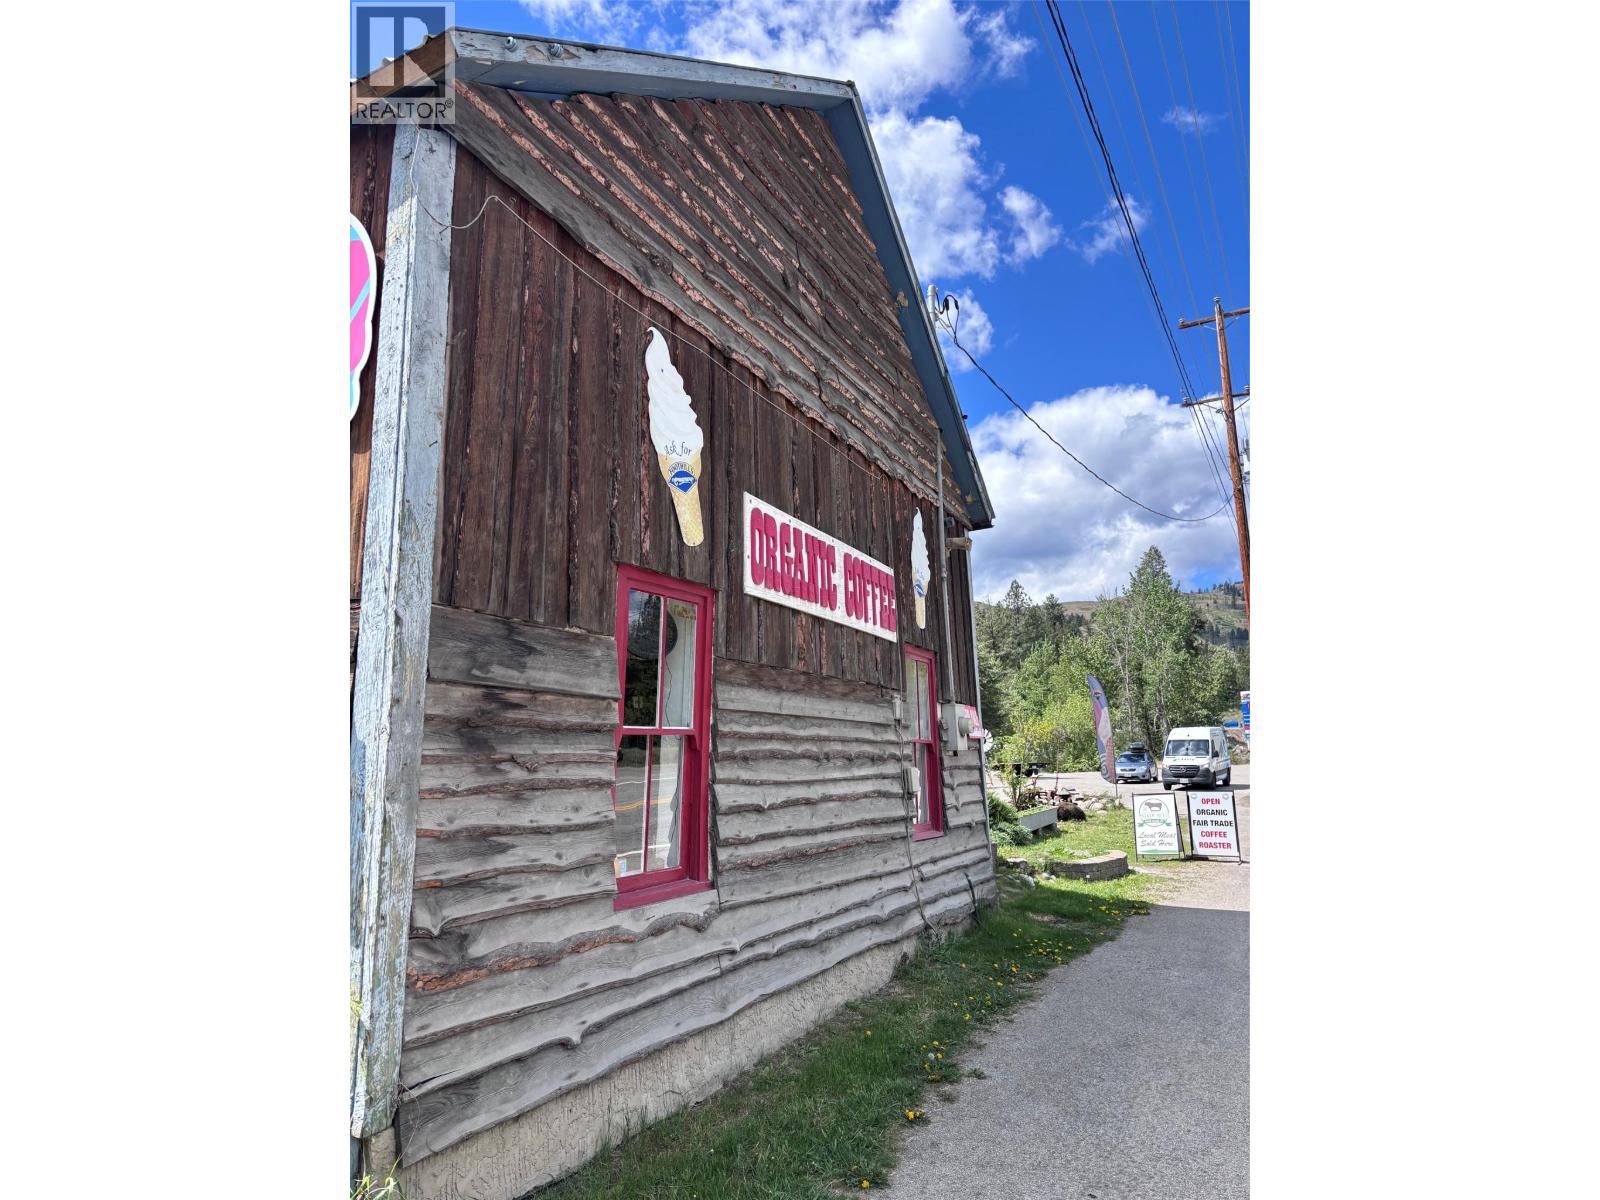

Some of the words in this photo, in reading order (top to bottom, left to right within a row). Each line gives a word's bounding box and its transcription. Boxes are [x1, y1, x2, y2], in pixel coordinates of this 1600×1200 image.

[750, 507, 838, 611] ORGANIC
[843, 552, 897, 632] COFFEE
[1192, 819, 1209, 827] FAIR
[1211, 819, 1234, 827] TRADE
[1200, 830, 1228, 838] COFFEE
[1198, 841, 1232, 849] ROASTER
